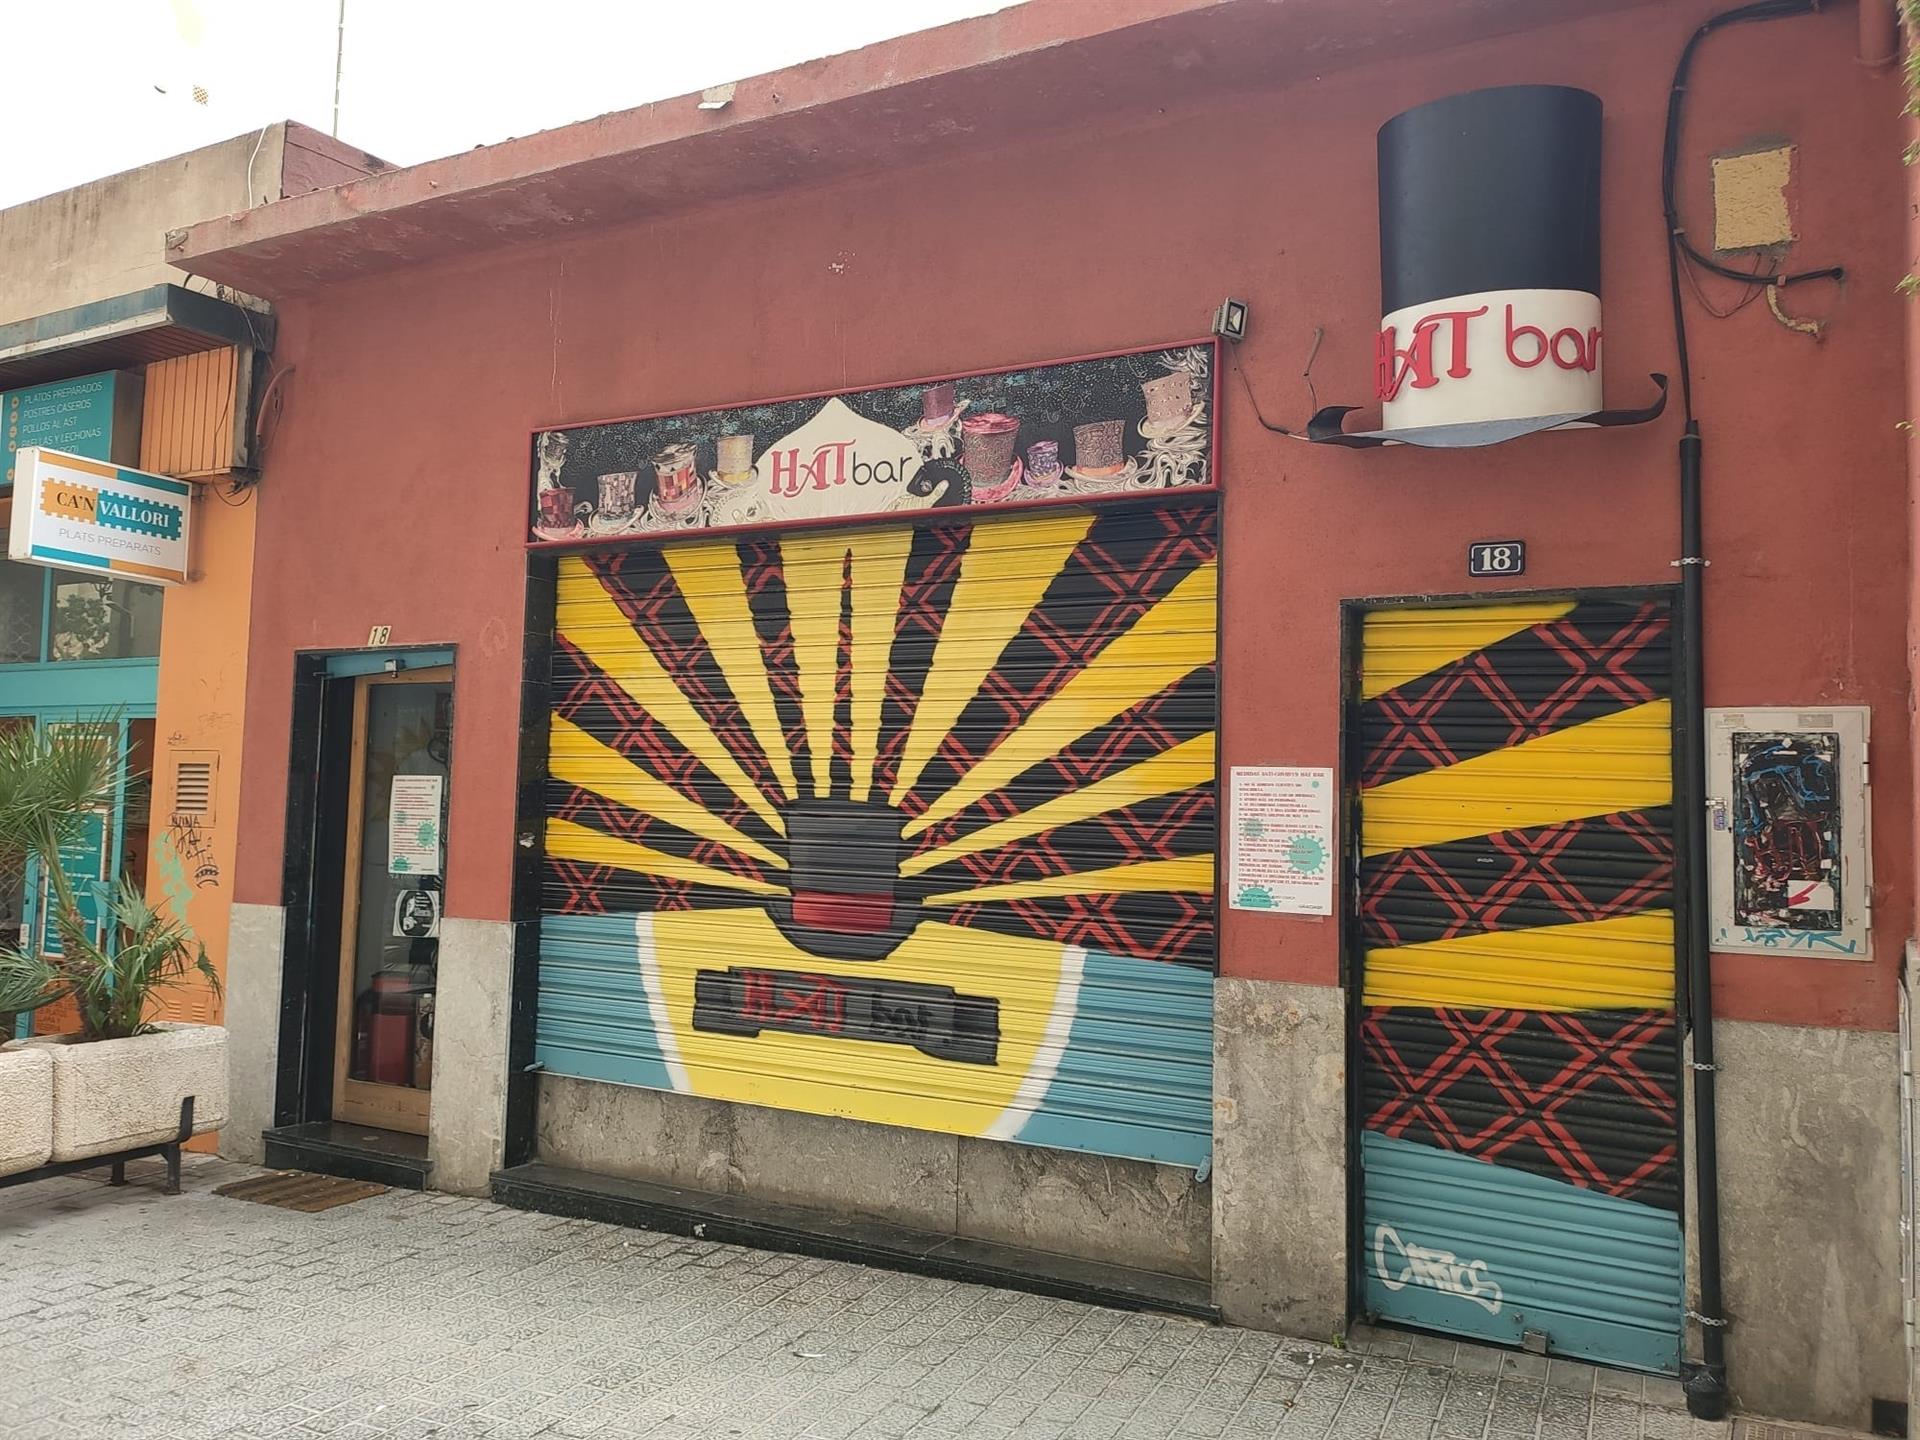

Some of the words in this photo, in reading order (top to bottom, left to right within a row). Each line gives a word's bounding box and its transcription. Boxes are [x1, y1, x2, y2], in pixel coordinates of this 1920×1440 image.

[1505, 303, 1602, 372] bar
[24, 391, 52, 404] PLATOS
[52, 381, 103, 399] PREPARADOS
[23, 404, 56, 418] POSTRES
[56, 398, 92, 413] CASEROS
[22, 420, 51, 433] POLLOS
[52, 419, 61, 429] AL
[63, 416, 78, 426] AST
[60, 427, 102, 443] LECHONAS
[769, 438, 856, 498] HAT
[852, 451, 913, 486] bar
[56, 491, 96, 512] CA'N
[99, 500, 170, 528] VALLORI
[58, 528, 96, 544] PLATS
[97, 535, 162, 556] PREPARATS
[1481, 547, 1511, 571] 18
[371, 627, 389, 645] 18
